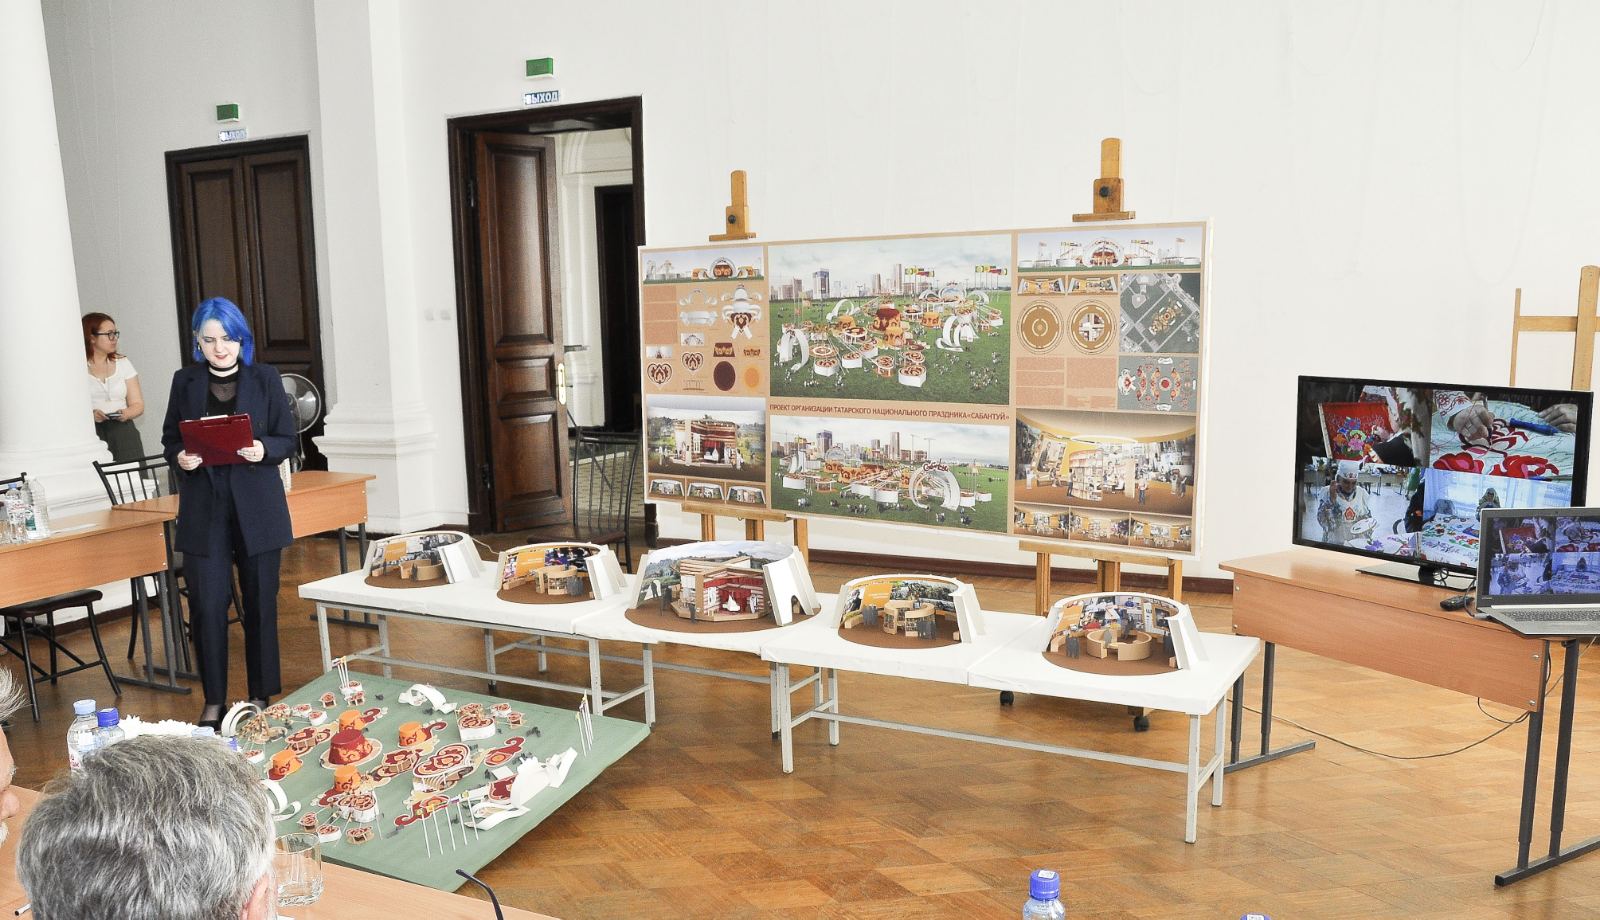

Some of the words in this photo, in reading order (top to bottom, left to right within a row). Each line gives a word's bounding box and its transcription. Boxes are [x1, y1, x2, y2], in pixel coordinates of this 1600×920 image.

[791, 405, 832, 413] ОРГАНИЗАЦИИ
[834, 406, 871, 414] ТАТАРСКОГО
[872, 408, 927, 417] НАЦИОНАЛЬНОГО
